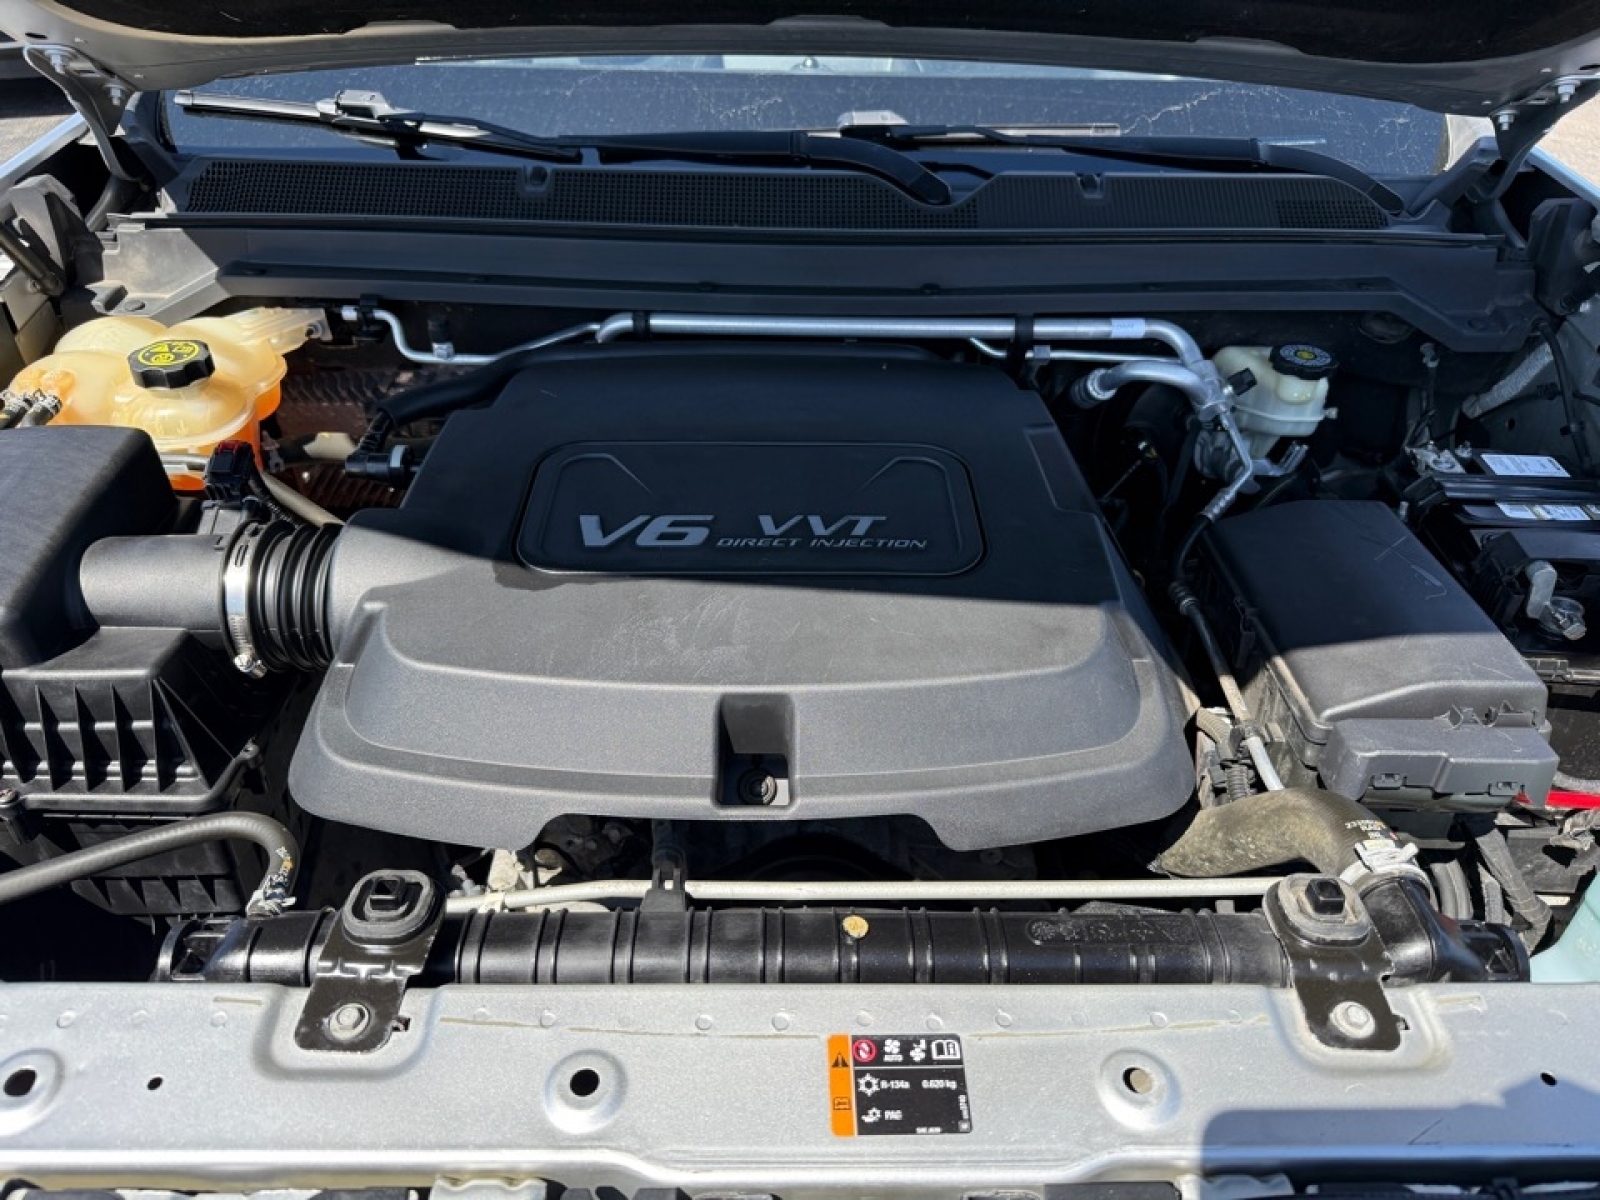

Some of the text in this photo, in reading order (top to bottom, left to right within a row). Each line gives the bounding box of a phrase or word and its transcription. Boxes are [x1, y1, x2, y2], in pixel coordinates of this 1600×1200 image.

[579, 514, 887, 548] V6 VVT
[715, 537, 927, 549] DIRECT INJECTION
